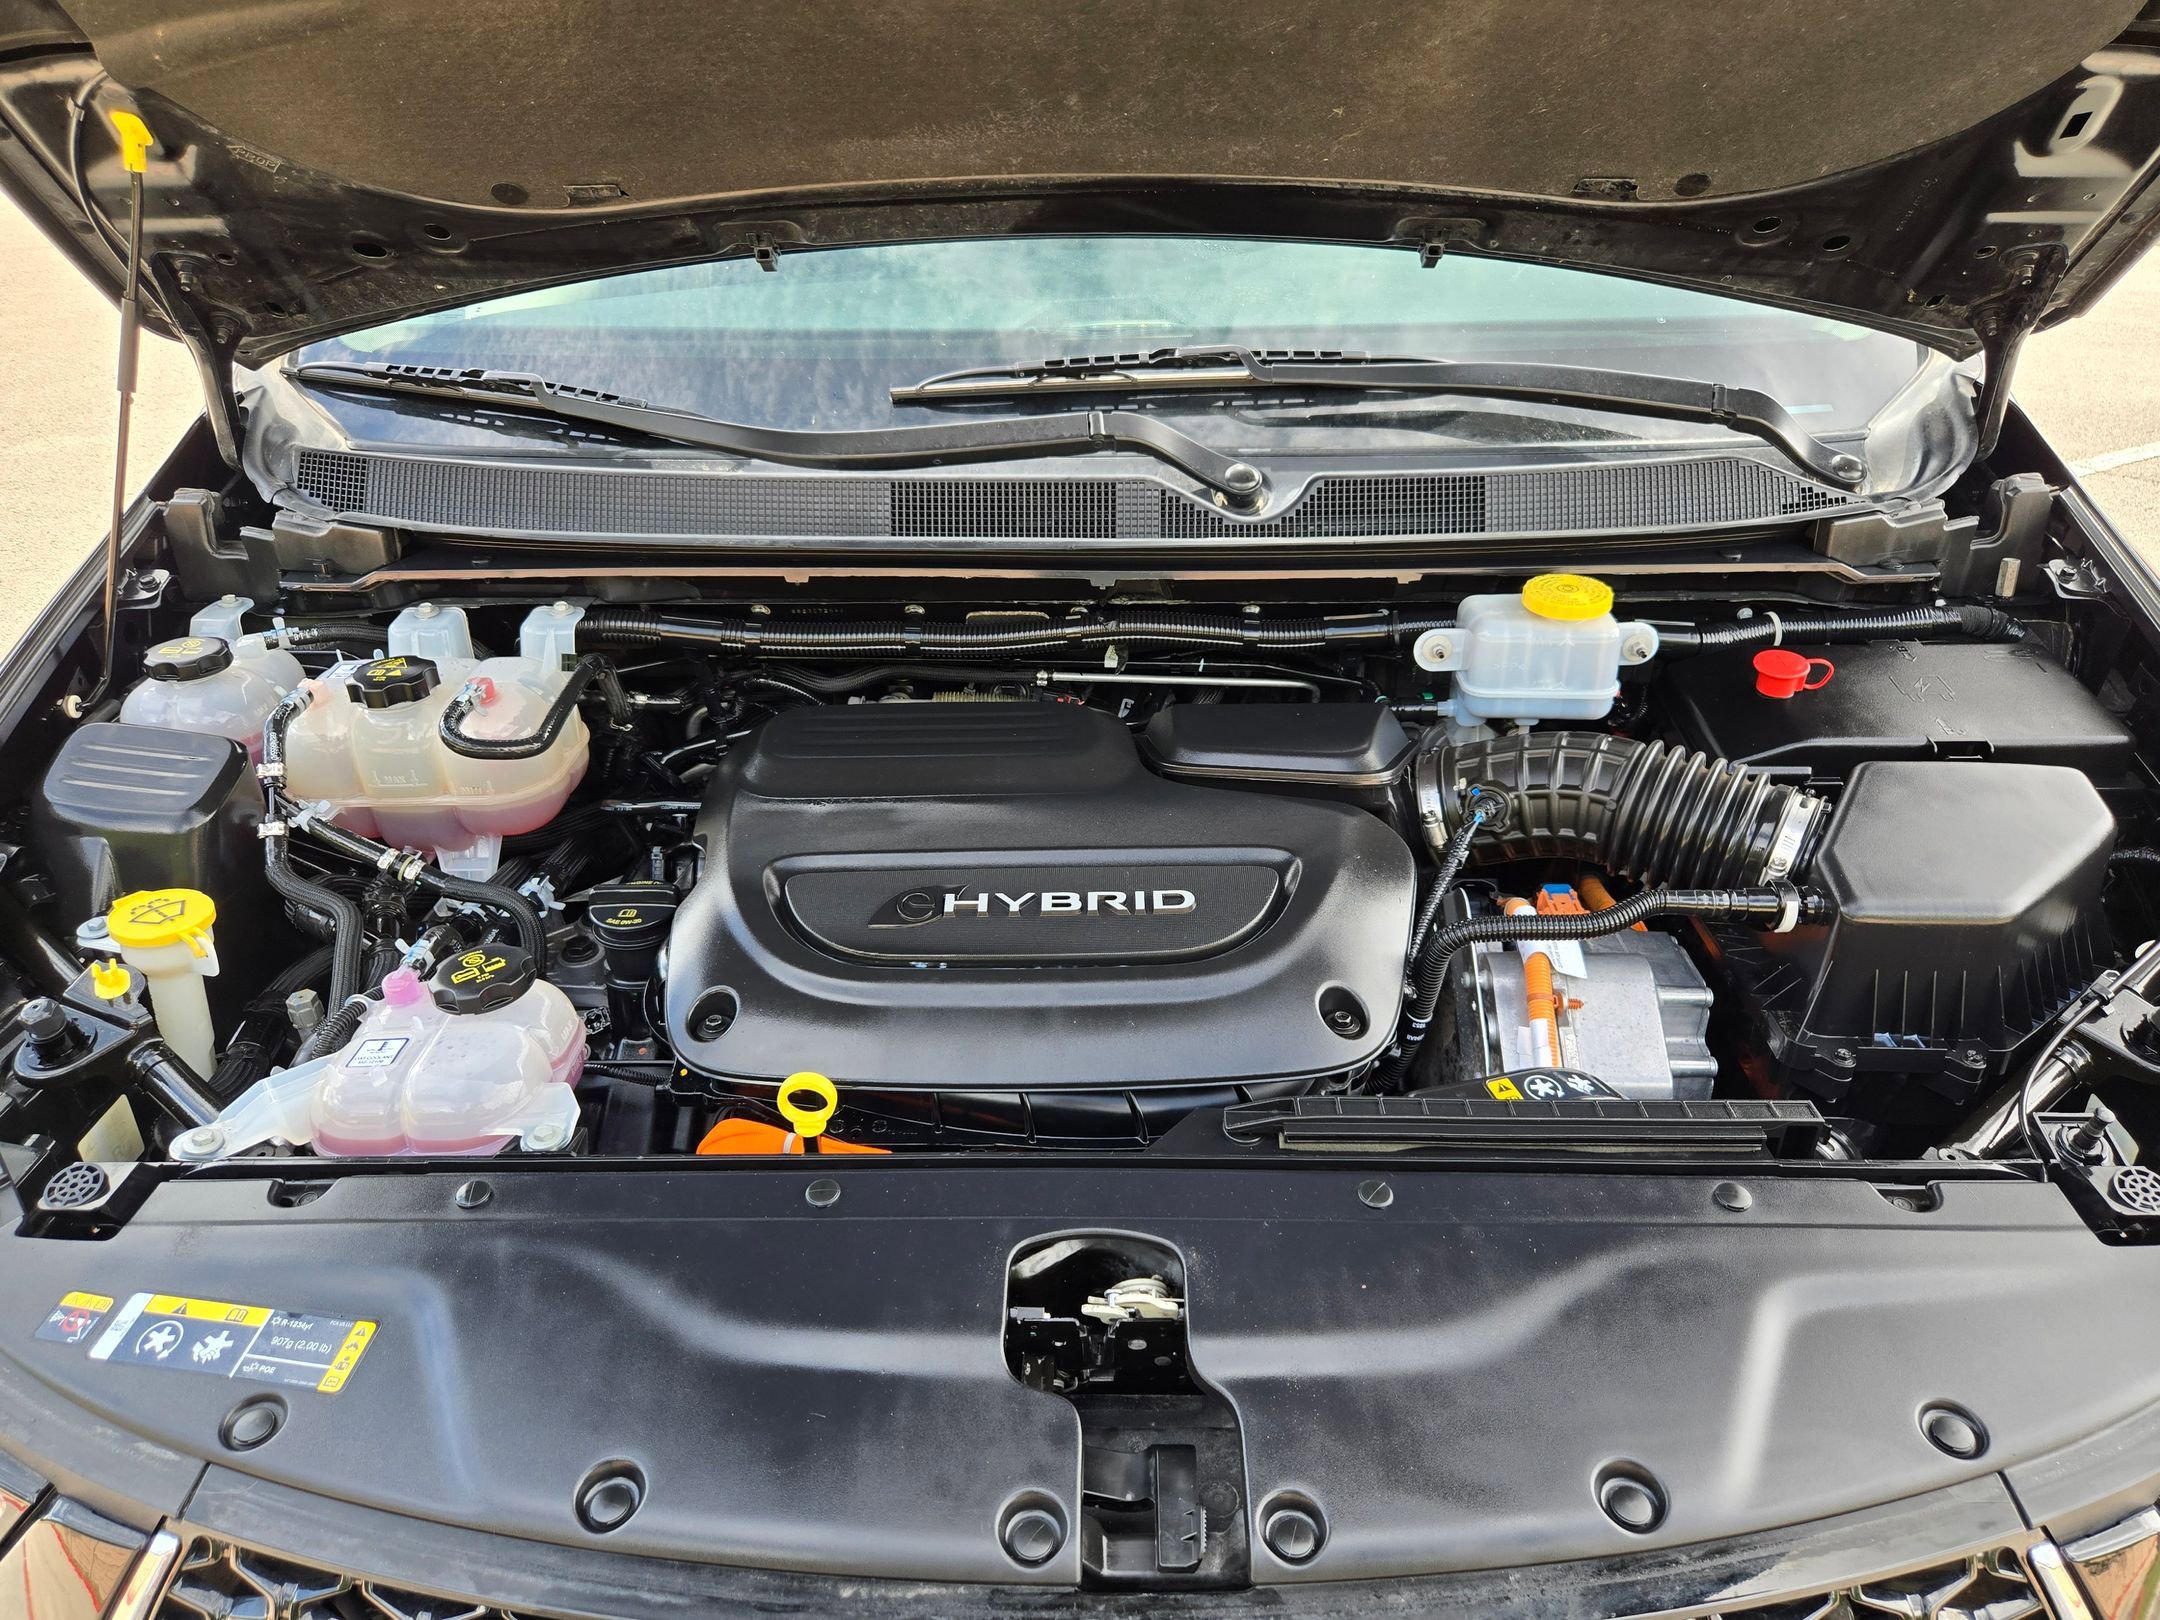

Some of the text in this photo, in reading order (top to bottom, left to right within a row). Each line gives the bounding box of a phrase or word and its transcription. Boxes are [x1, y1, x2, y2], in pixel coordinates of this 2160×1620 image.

[233, 148, 276, 167] PROP
[271, 1335, 294, 1349] 907g
[319, 1342, 332, 1354] lb)
[259, 1364, 277, 1375] POE
